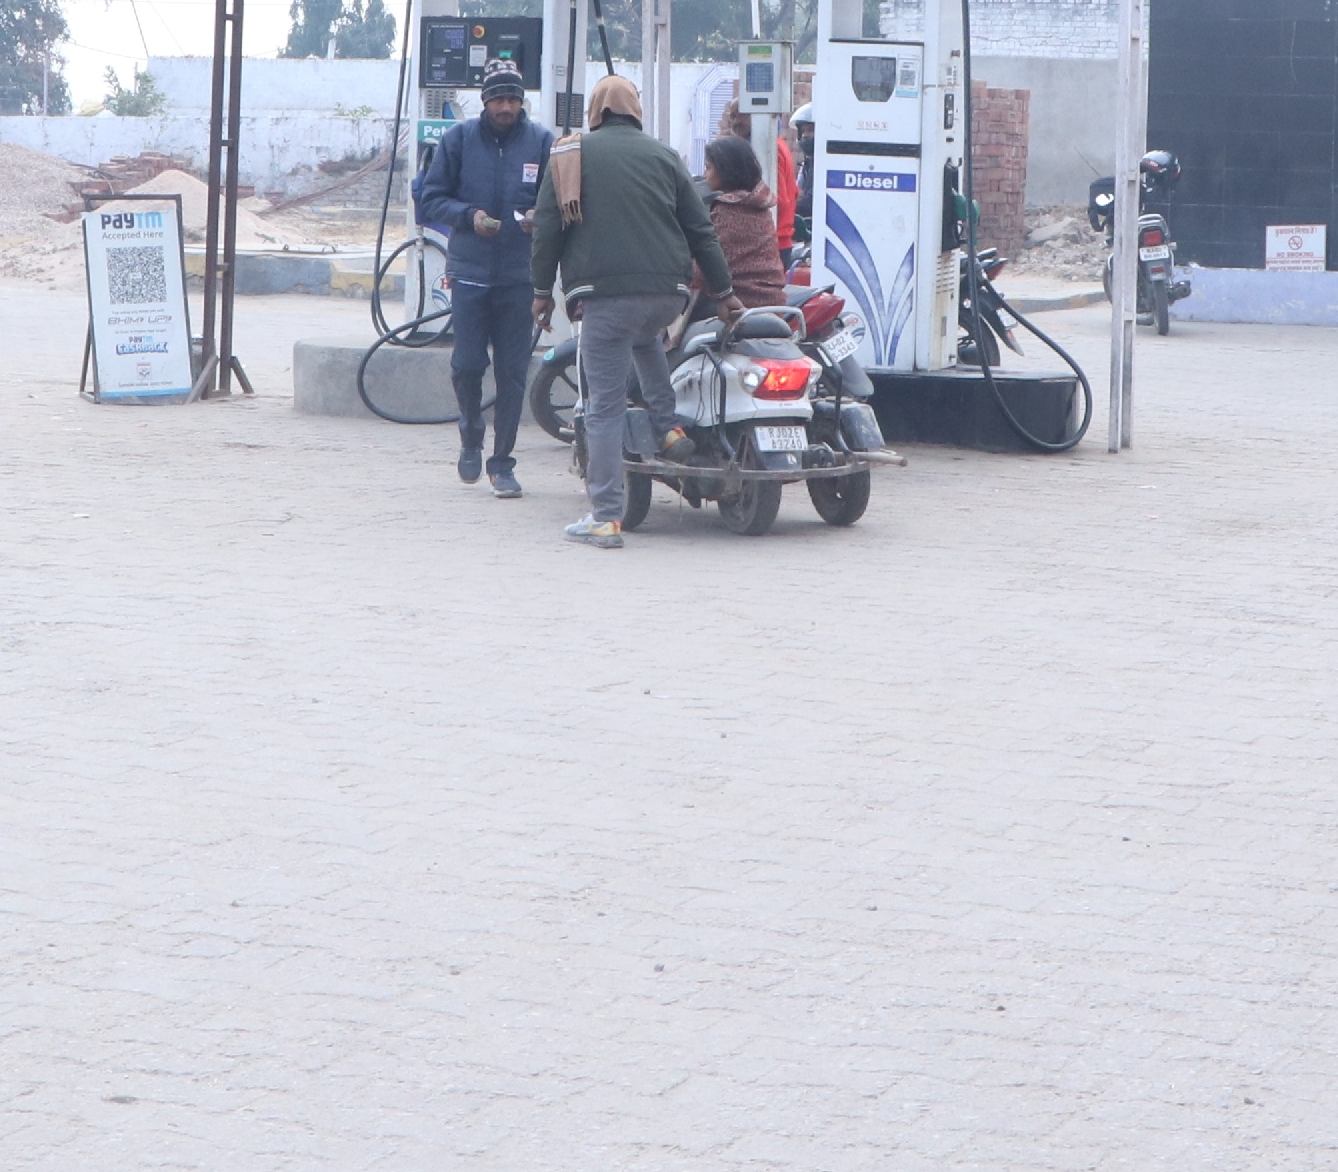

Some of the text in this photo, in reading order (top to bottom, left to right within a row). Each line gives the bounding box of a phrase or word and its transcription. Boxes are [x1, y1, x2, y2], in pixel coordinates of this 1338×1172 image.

[423, 125, 446, 137] Pet
[844, 173, 898, 189] Diesel
[102, 230, 164, 241] Accepted Here
[108, 317, 143, 325] BHIM
[768, 428, 800, 438] RJ02E
